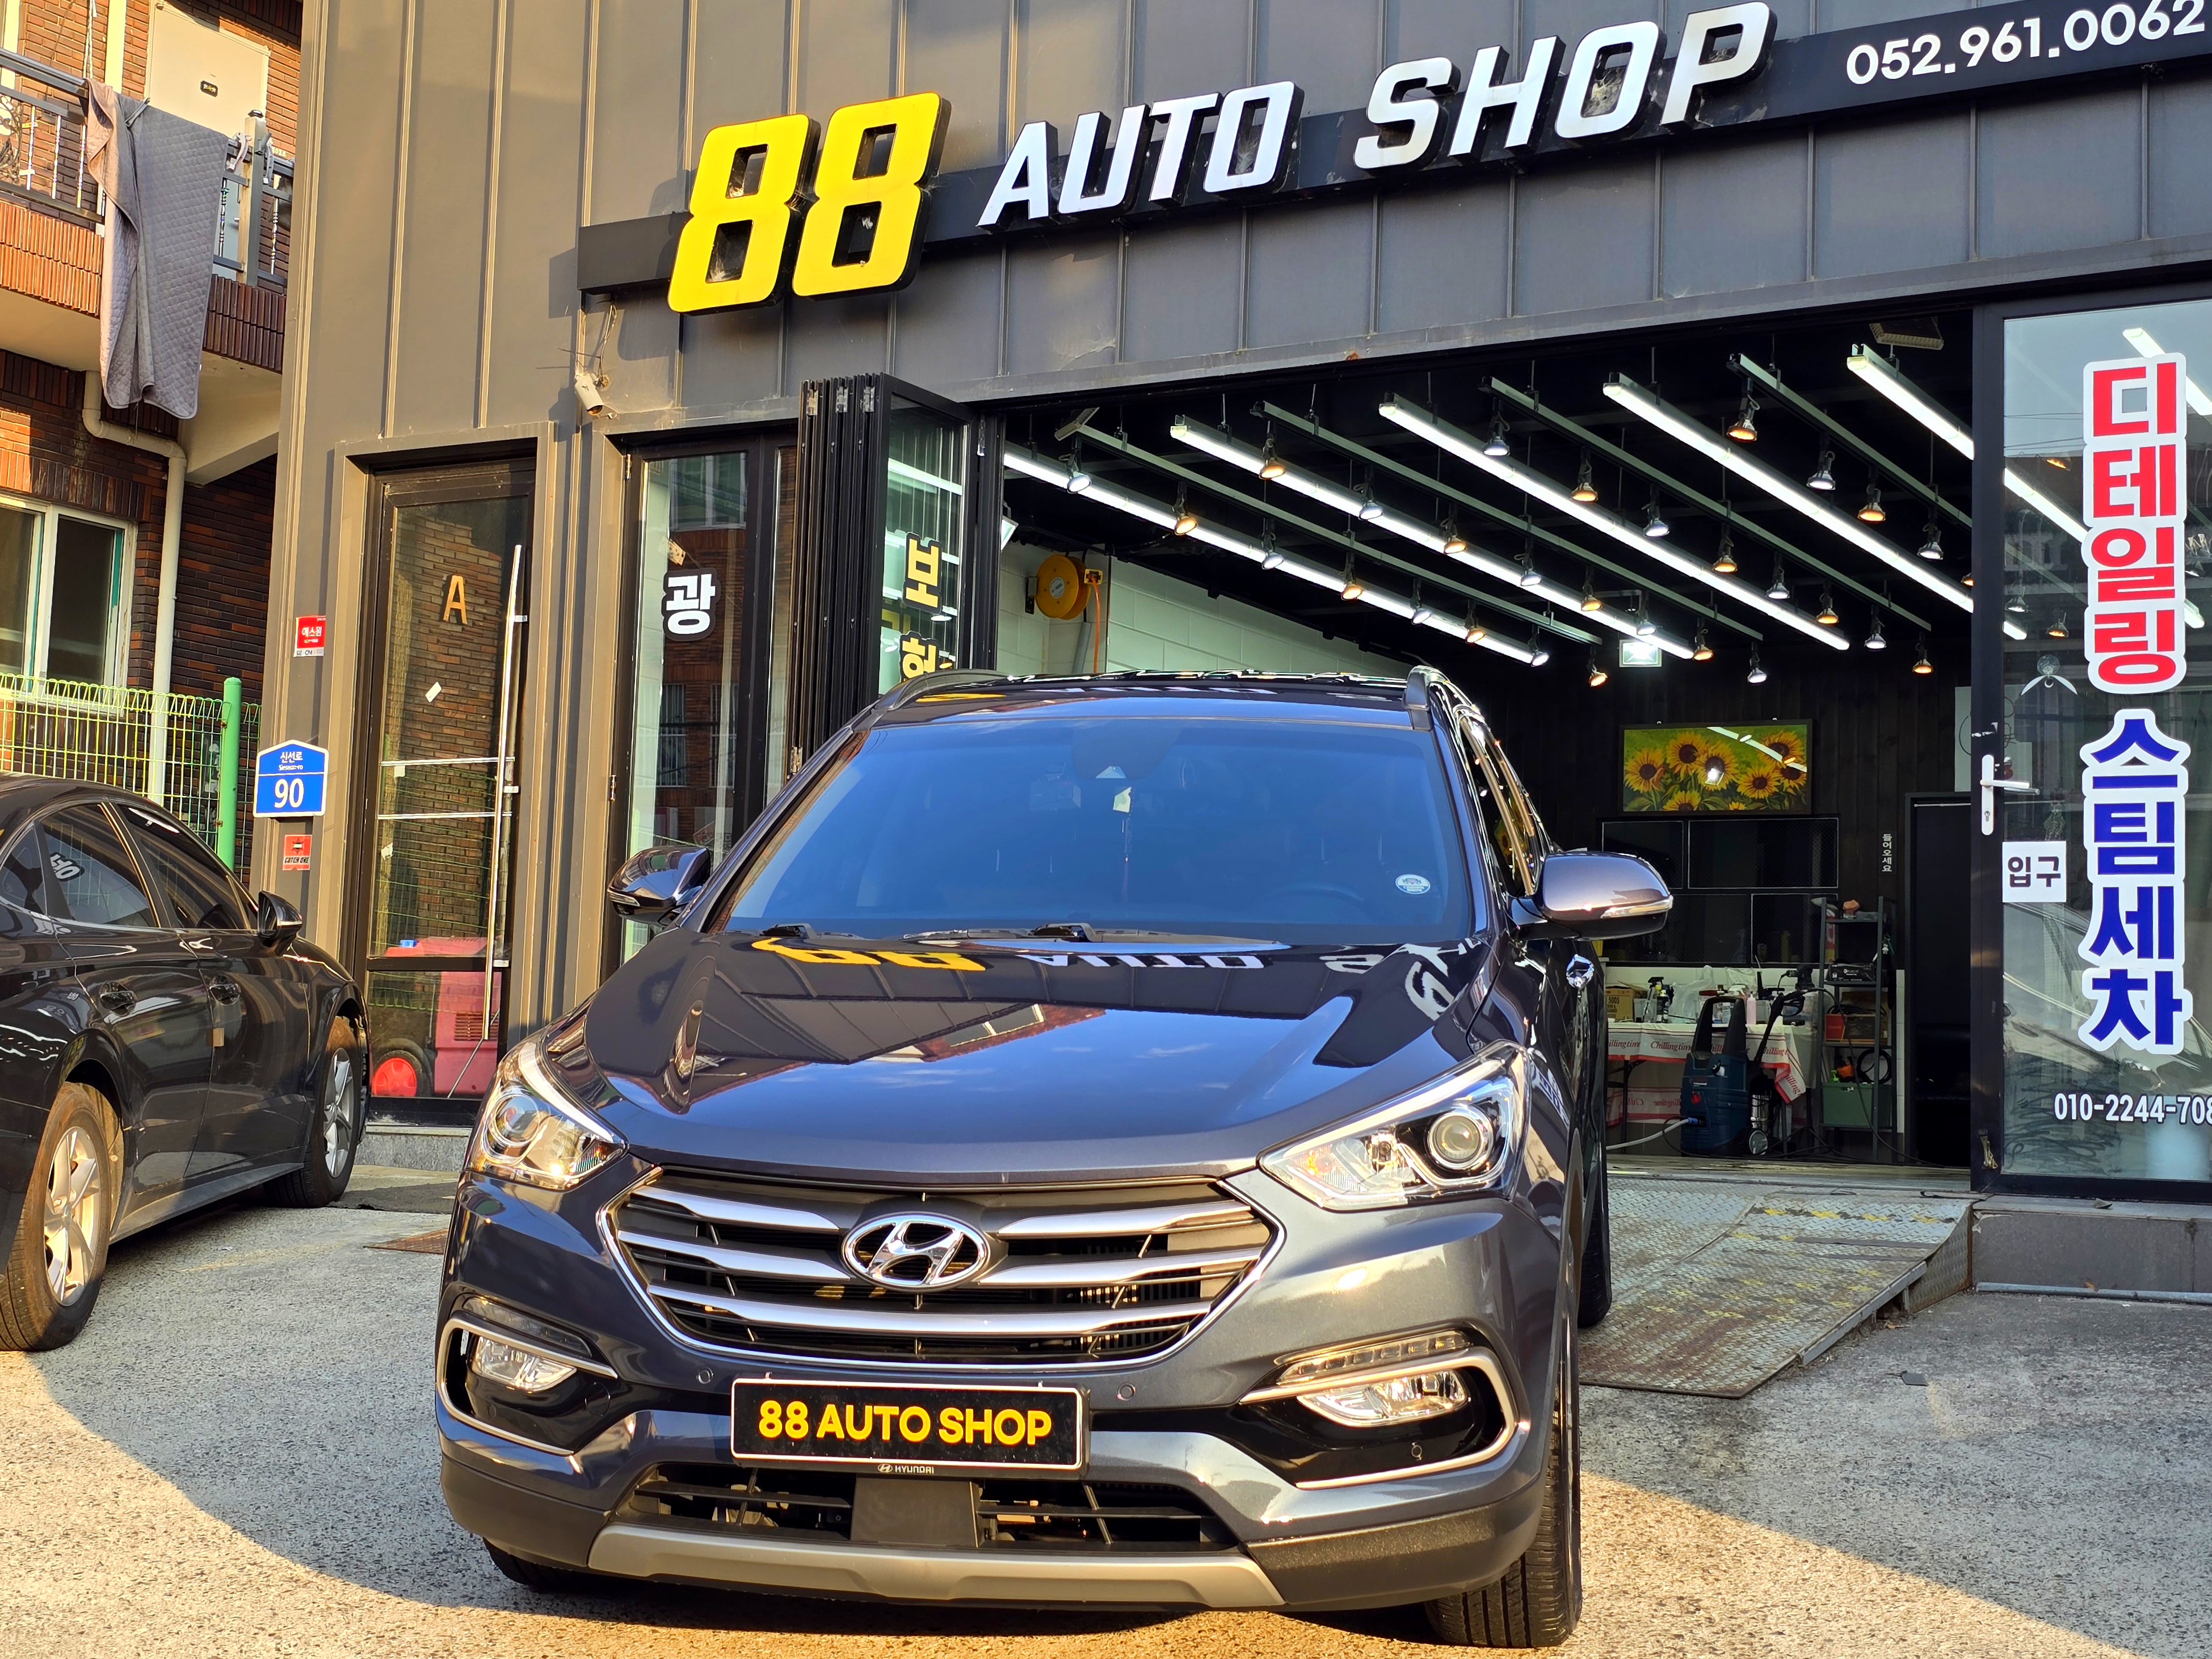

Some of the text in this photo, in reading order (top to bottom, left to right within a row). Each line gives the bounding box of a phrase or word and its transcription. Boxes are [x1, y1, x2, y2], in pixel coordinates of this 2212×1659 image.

[1847, 0, 2205, 85] 052.961.0062
[667, 2, 1773, 313] 88 AUTO SHOP
[443, 575, 468, 625] A
[666, 573, 716, 635] 광
[2089, 362, 2183, 1046] 디테일링 스팀세차
[280, 751, 304, 764] 신선로
[274, 778, 304, 809] 90
[1881, 833, 1893, 873] 들어오세요
[2007, 856, 2062, 888] 입구
[758, 1400, 1053, 1446] 88 AUTO SHOP
[894, 1465, 935, 1475] HYUNDAI
